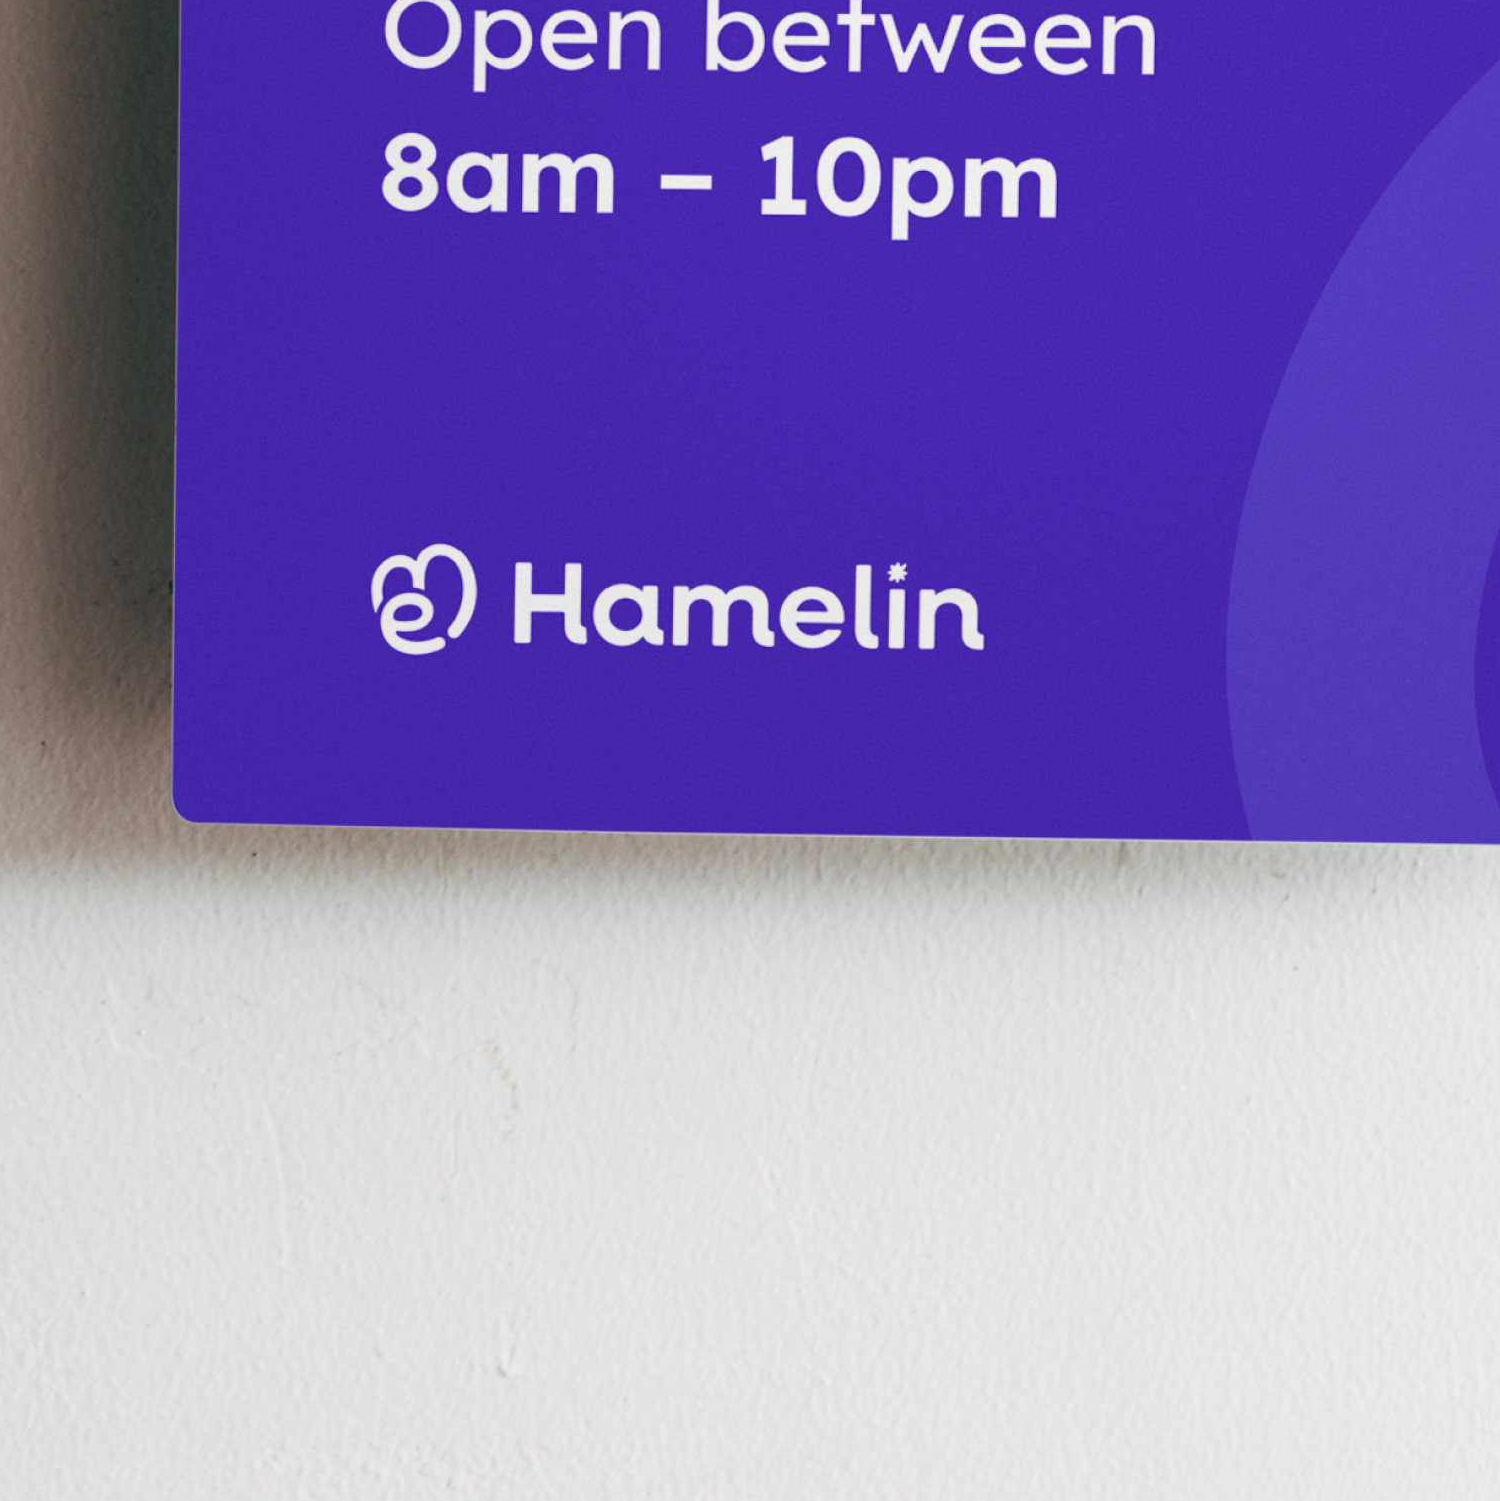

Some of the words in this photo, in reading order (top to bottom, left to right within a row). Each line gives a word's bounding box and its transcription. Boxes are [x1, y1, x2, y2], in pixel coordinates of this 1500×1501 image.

[382, 133, 614, 214] 8am
[760, 137, 1057, 241] 10pm
[514, 562, 985, 650] Hamelin
